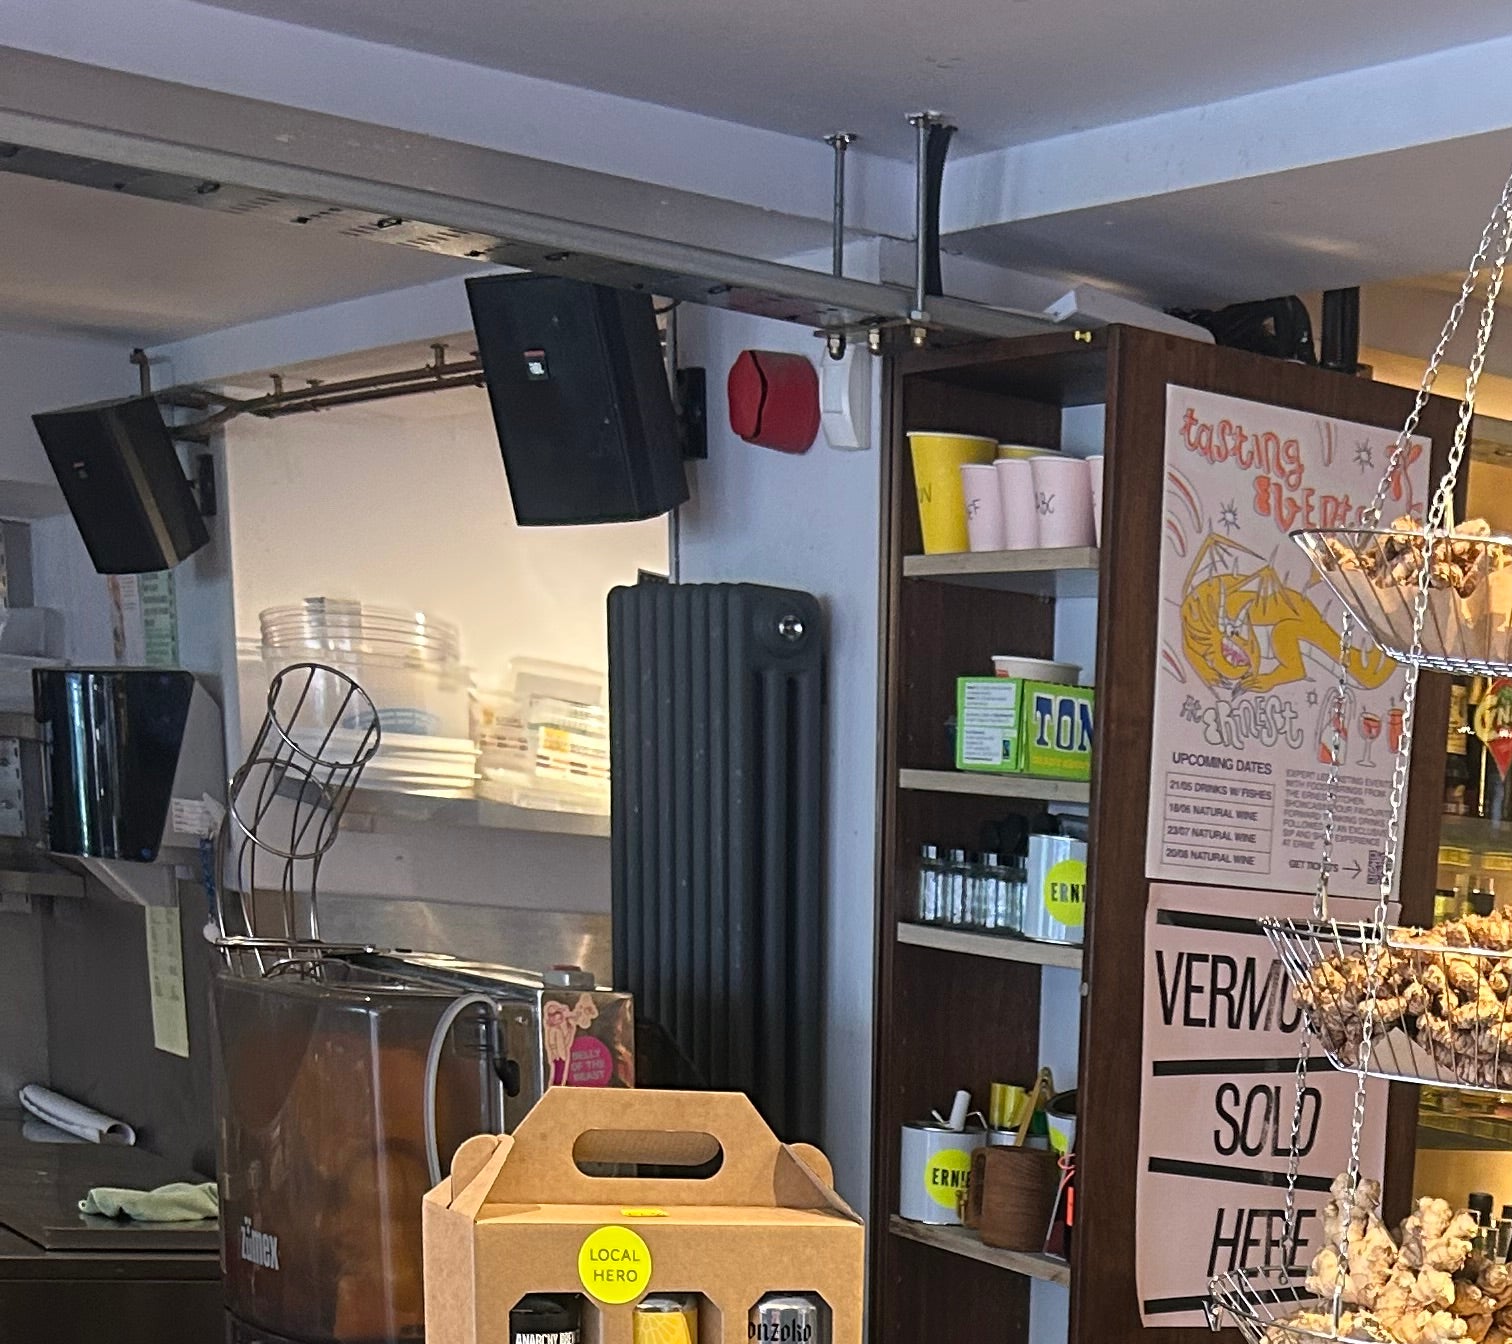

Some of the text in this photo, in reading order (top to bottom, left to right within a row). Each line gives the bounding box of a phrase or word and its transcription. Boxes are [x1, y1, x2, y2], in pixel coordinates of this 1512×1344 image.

[1172, 752, 1272, 775] UPCOMING DATES
[1194, 782, 1228, 796] DRINKS
[1242, 787, 1272, 800] FISHES
[1192, 805, 1235, 819] NATURAL
[1236, 809, 1258, 821] WINE
[1191, 829, 1232, 842] NATURAL
[1234, 832, 1257, 844] WINE
[1190, 850, 1231, 865] NATURAL
[1233, 854, 1256, 866] WINE
[1156, 949, 1301, 1034] VERMO
[1214, 1082, 1322, 1158] SOLD
[1207, 1207, 1317, 1279] HERE
[590, 1248, 641, 1263] LOCAL
[593, 1269, 638, 1282] HERO
[748, 1318, 812, 1342] onzoko
